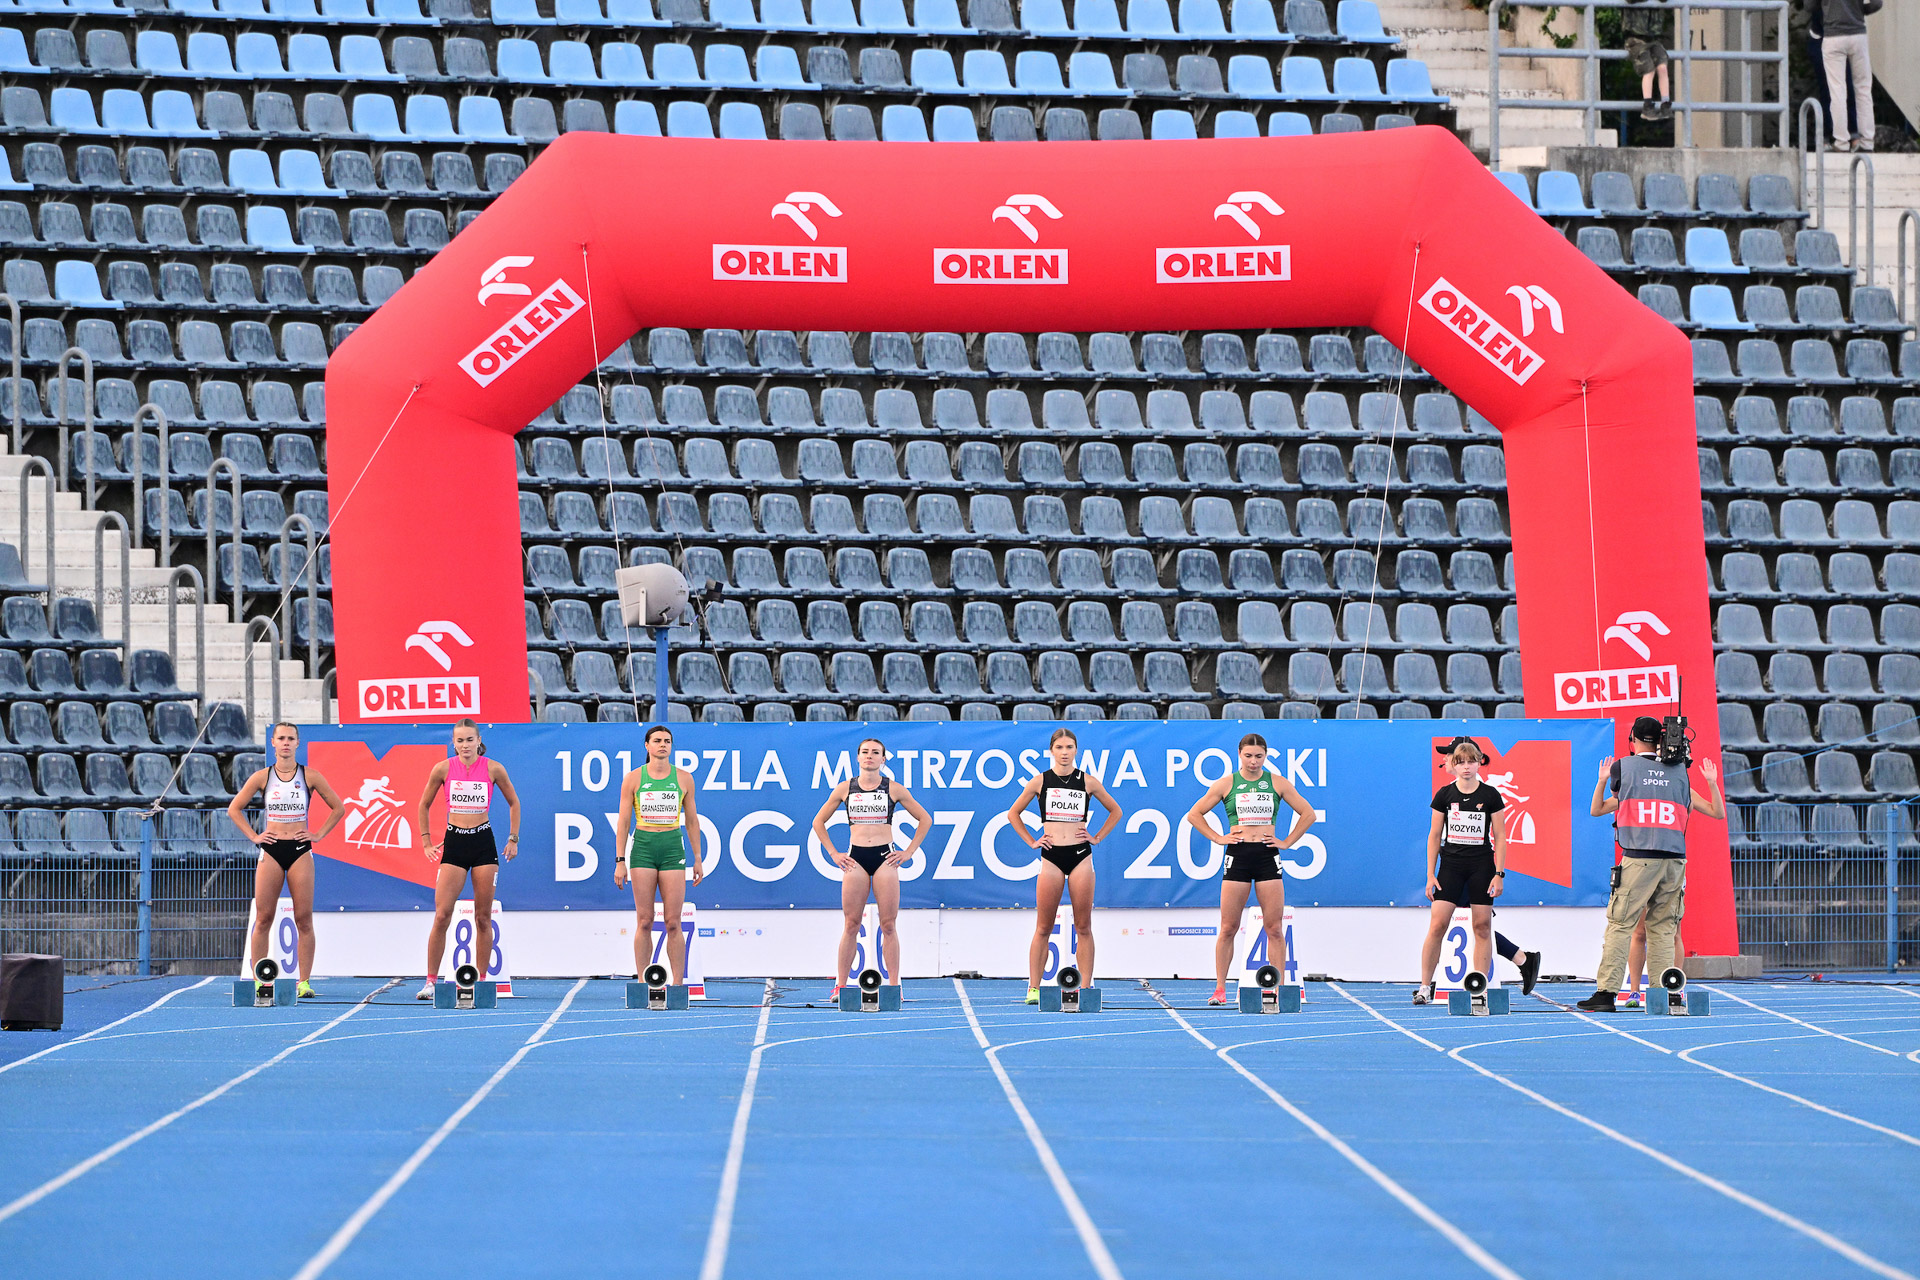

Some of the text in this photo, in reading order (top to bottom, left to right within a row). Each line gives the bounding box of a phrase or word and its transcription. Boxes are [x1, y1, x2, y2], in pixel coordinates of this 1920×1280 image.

[720, 250, 838, 277] ORLEN
[941, 254, 1059, 279] ORLEN
[1163, 251, 1282, 278] ORLEN
[472, 288, 575, 376] ORLEN
[1431, 290, 1534, 377] ORLEN
[364, 682, 472, 712] ORLEN
[1560, 671, 1671, 705] ORLEN
[674, 749, 791, 791] PZLA
[811, 747, 1149, 790] MSTRZOSTWA
[1166, 747, 1327, 788] POSKI
[1647, 769, 1665, 777] TVP
[1642, 778, 1670, 787] SPORT
[268, 803, 305, 811] BORZEWSKA
[290, 791, 300, 799] 71
[451, 794, 486, 803] ROZMYS
[661, 792, 676, 800] 366
[1051, 801, 1079, 810] POLAK
[1068, 791, 1083, 799] 463
[641, 804, 677, 812] GRANASZEWSKA
[849, 804, 887, 813] MIERZYŃSKA
[1468, 813, 1482, 821] 442
[1637, 801, 1676, 825] HB
[454, 827, 477, 835] NIKE
[1450, 824, 1482, 833] KOZYRA
[554, 808, 1328, 883] BDGOSZC 205
[279, 917, 299, 974] 9
[453, 919, 473, 971] 8
[1246, 925, 1270, 970] 4
[1444, 926, 1468, 983] 3
